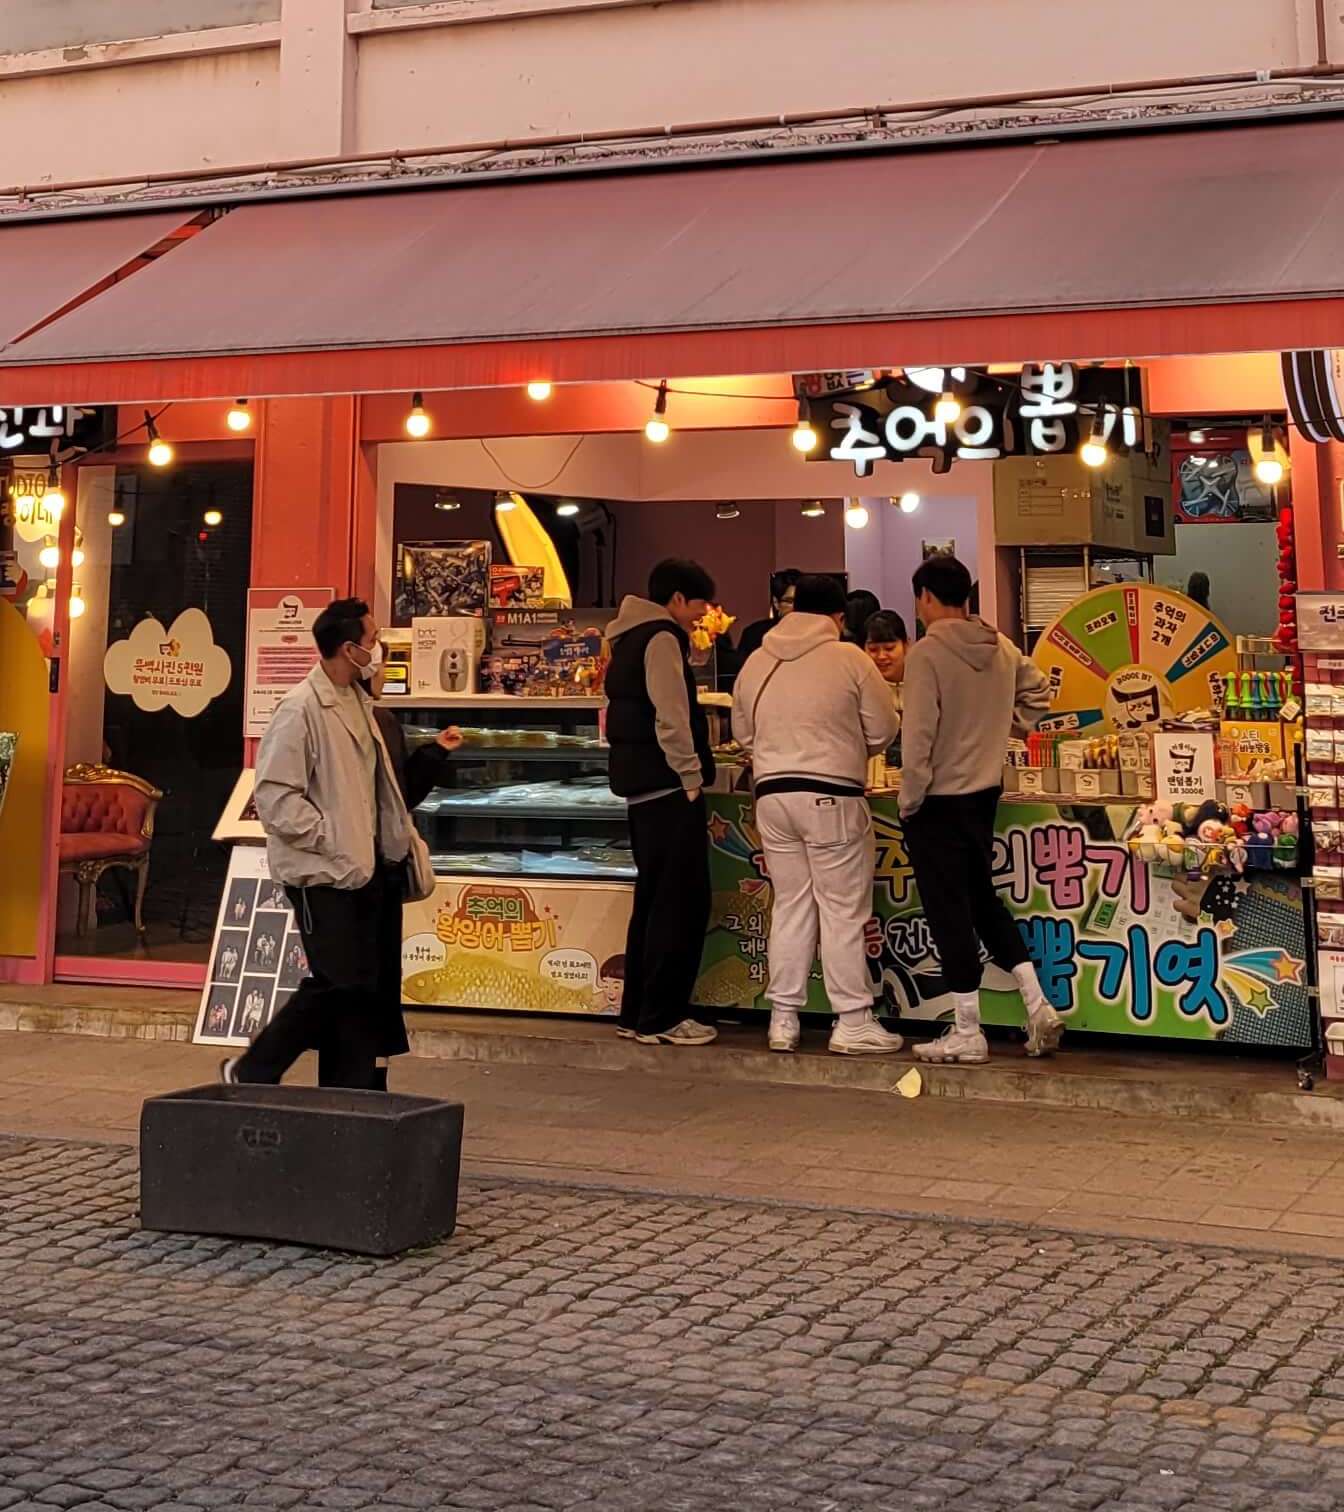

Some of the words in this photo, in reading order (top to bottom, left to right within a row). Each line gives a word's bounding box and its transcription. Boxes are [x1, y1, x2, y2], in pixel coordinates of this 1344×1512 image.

[508, 612, 537, 625] M1A1
[1153, 601, 1187, 622] 추억의
[1086, 611, 1118, 634] 프라모델
[1154, 616, 1179, 634] 과자
[1151, 630, 1173, 647] 2개
[466, 897, 523, 920] 추억의
[437, 912, 504, 951] 왕잉어
[510, 919, 556, 951] 뽑기
[726, 916, 741, 930] 그
[748, 914, 763, 935] 외
